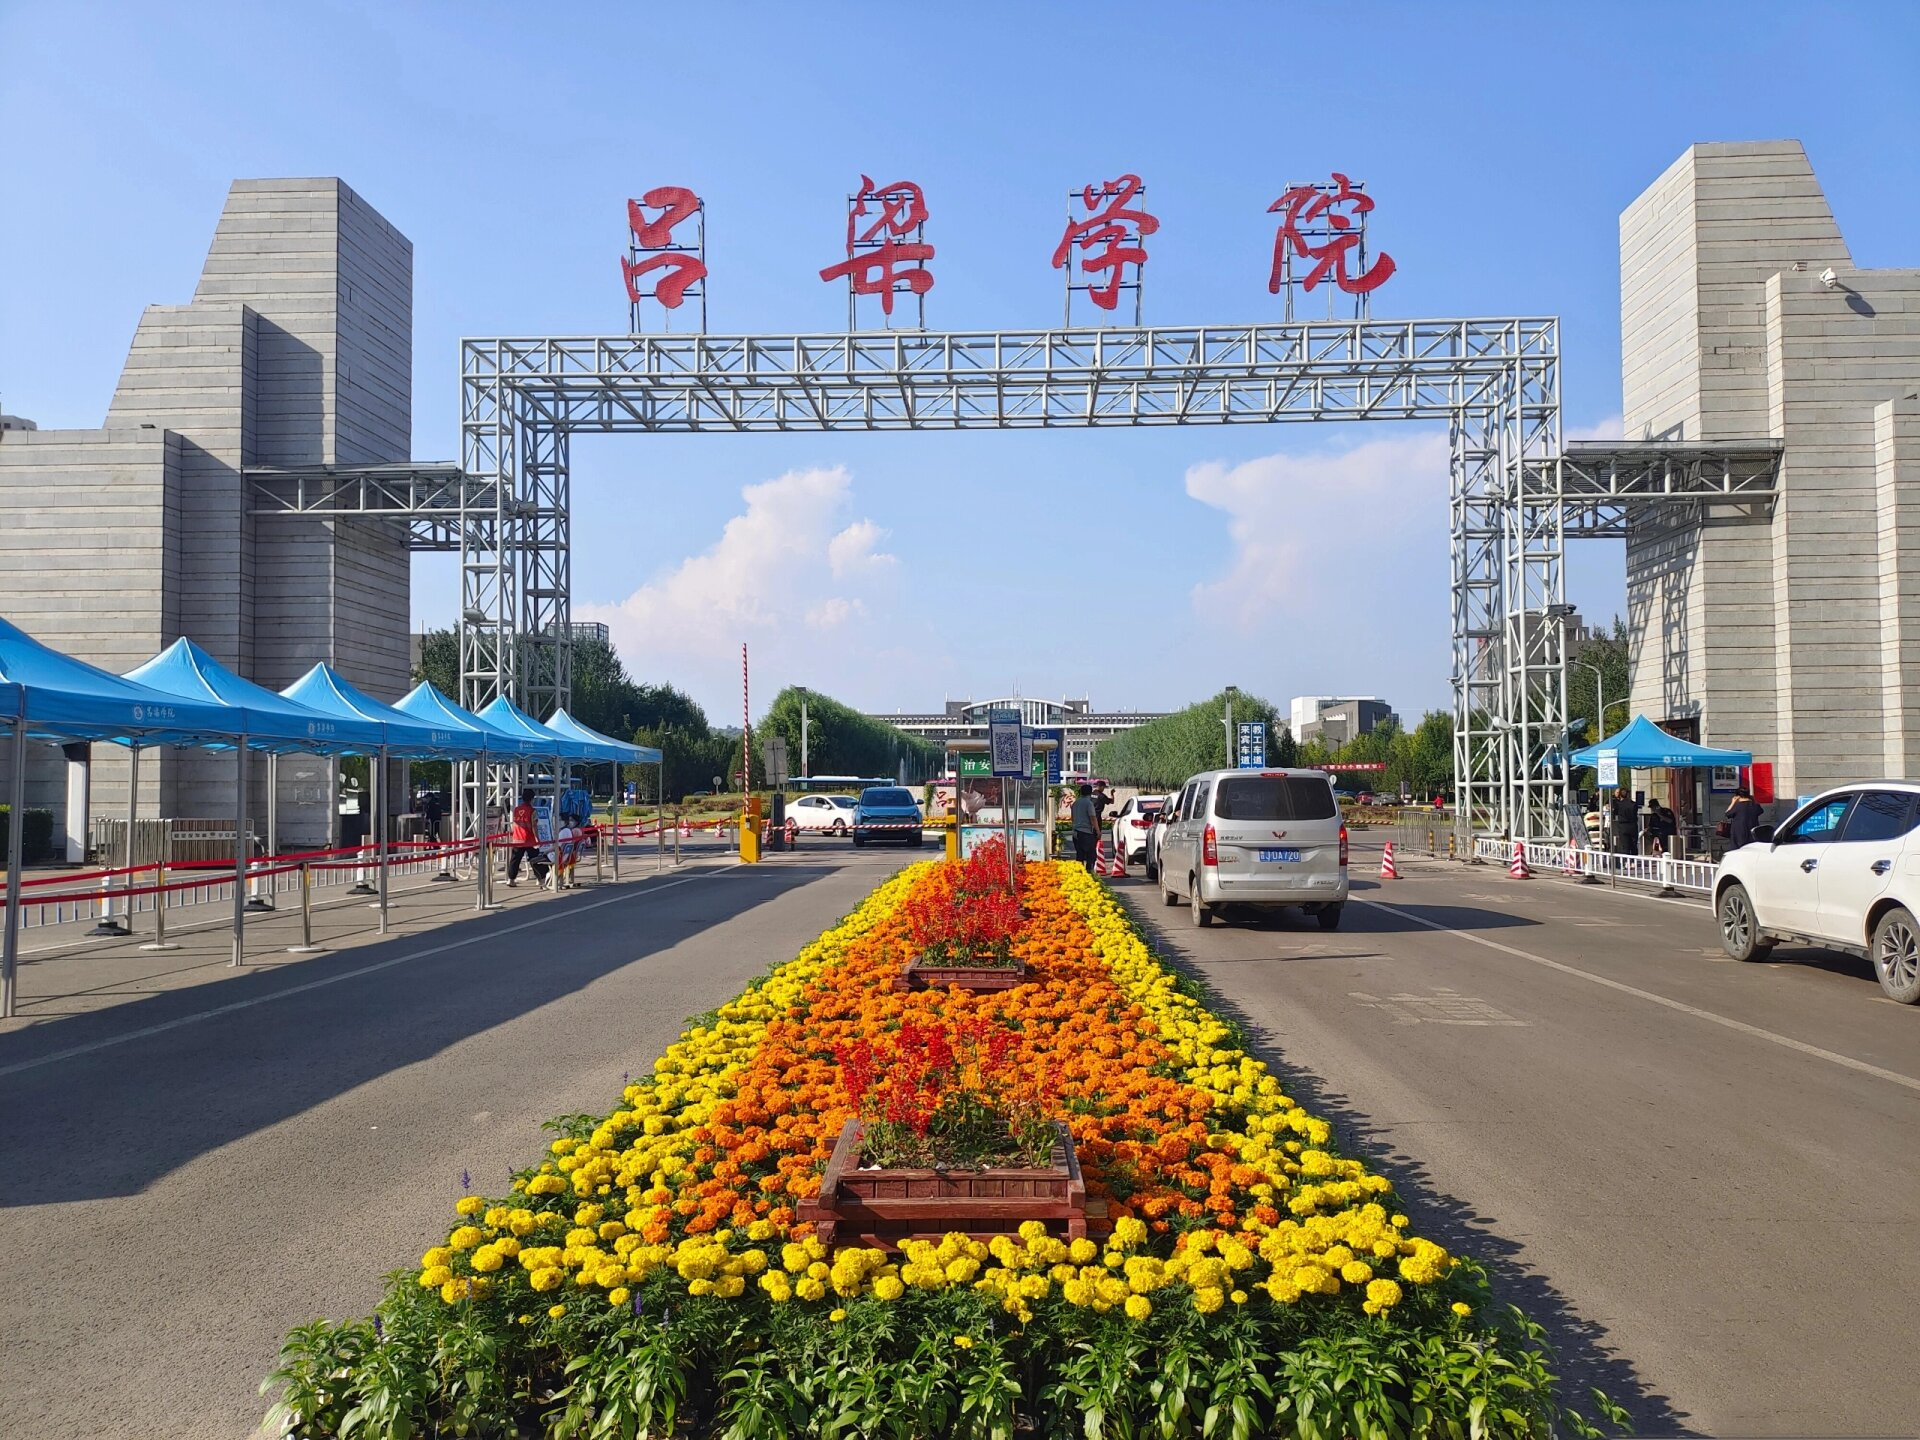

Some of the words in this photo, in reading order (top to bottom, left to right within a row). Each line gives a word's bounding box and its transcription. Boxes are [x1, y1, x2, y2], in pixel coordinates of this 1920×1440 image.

[621, 173, 1396, 314] 吕梁学院
[1240, 725, 1251, 765] 来宾车道
[1252, 725, 1263, 765] 教工车道
